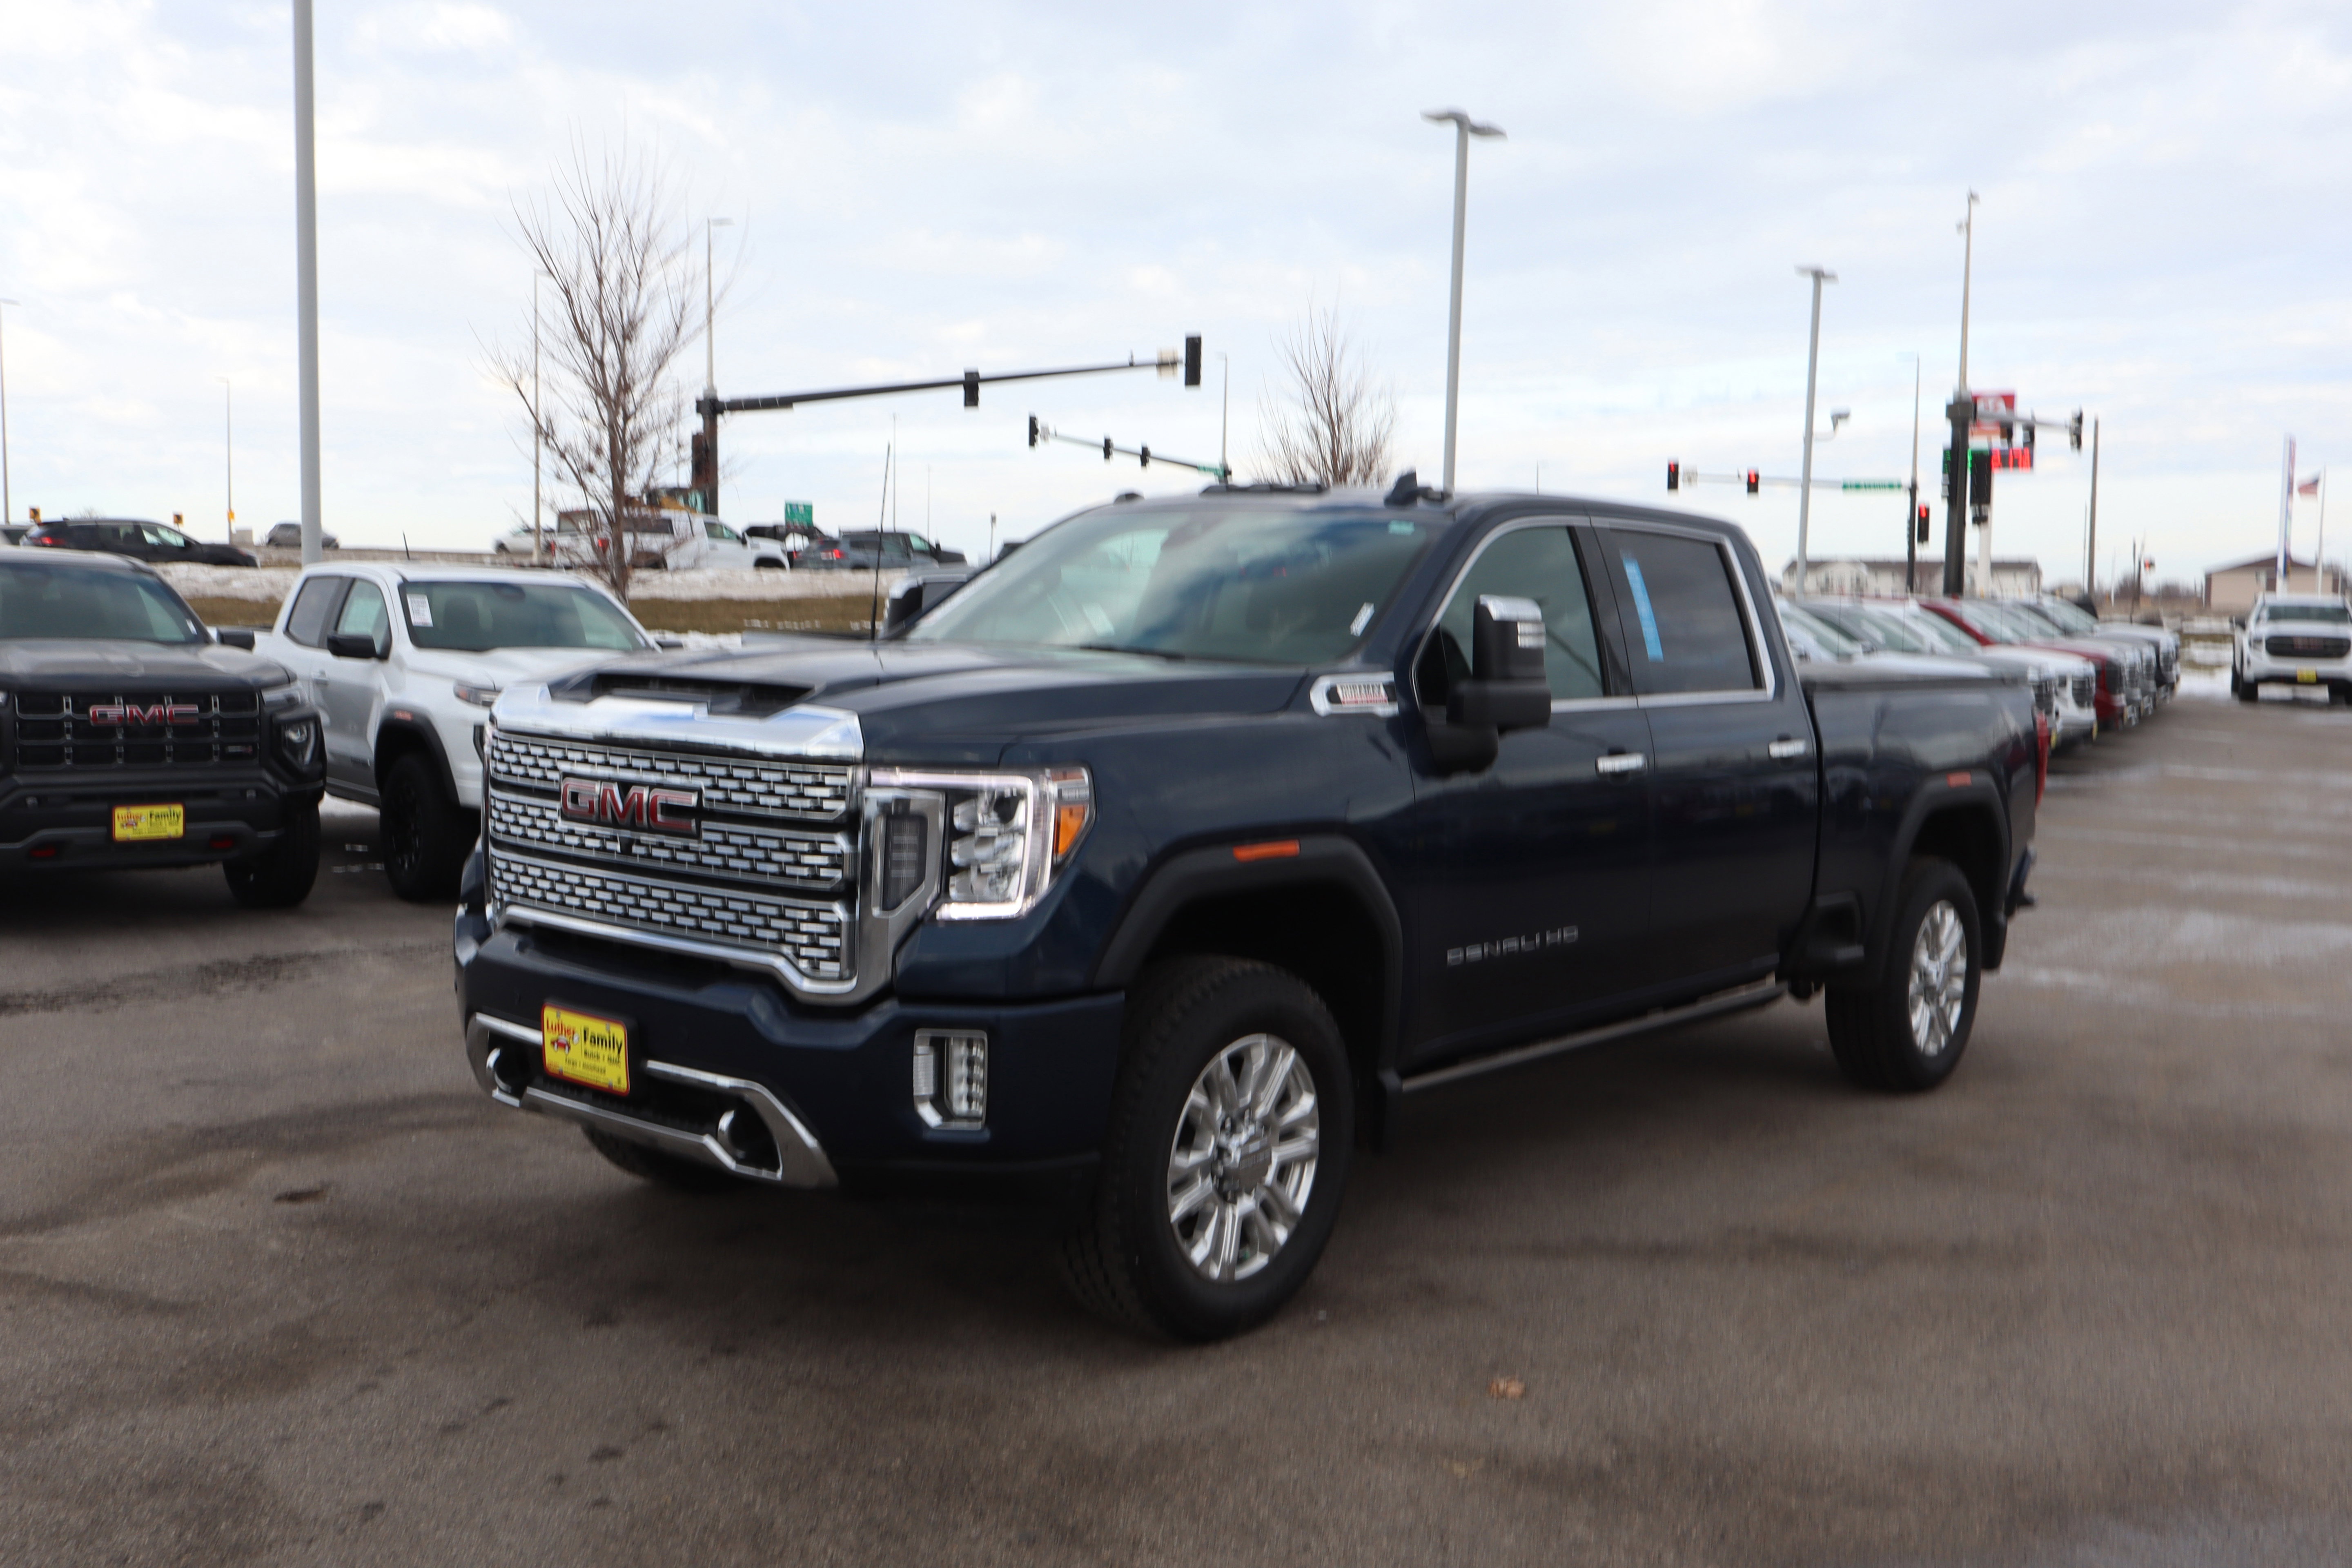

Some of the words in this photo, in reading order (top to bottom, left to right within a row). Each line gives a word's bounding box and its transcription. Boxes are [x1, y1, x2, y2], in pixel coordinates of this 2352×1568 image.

[89, 704, 199, 726] GMC
[561, 777, 698, 834] GMC
[1447, 931, 1541, 967] DENALI
[583, 1027, 623, 1058] Family
